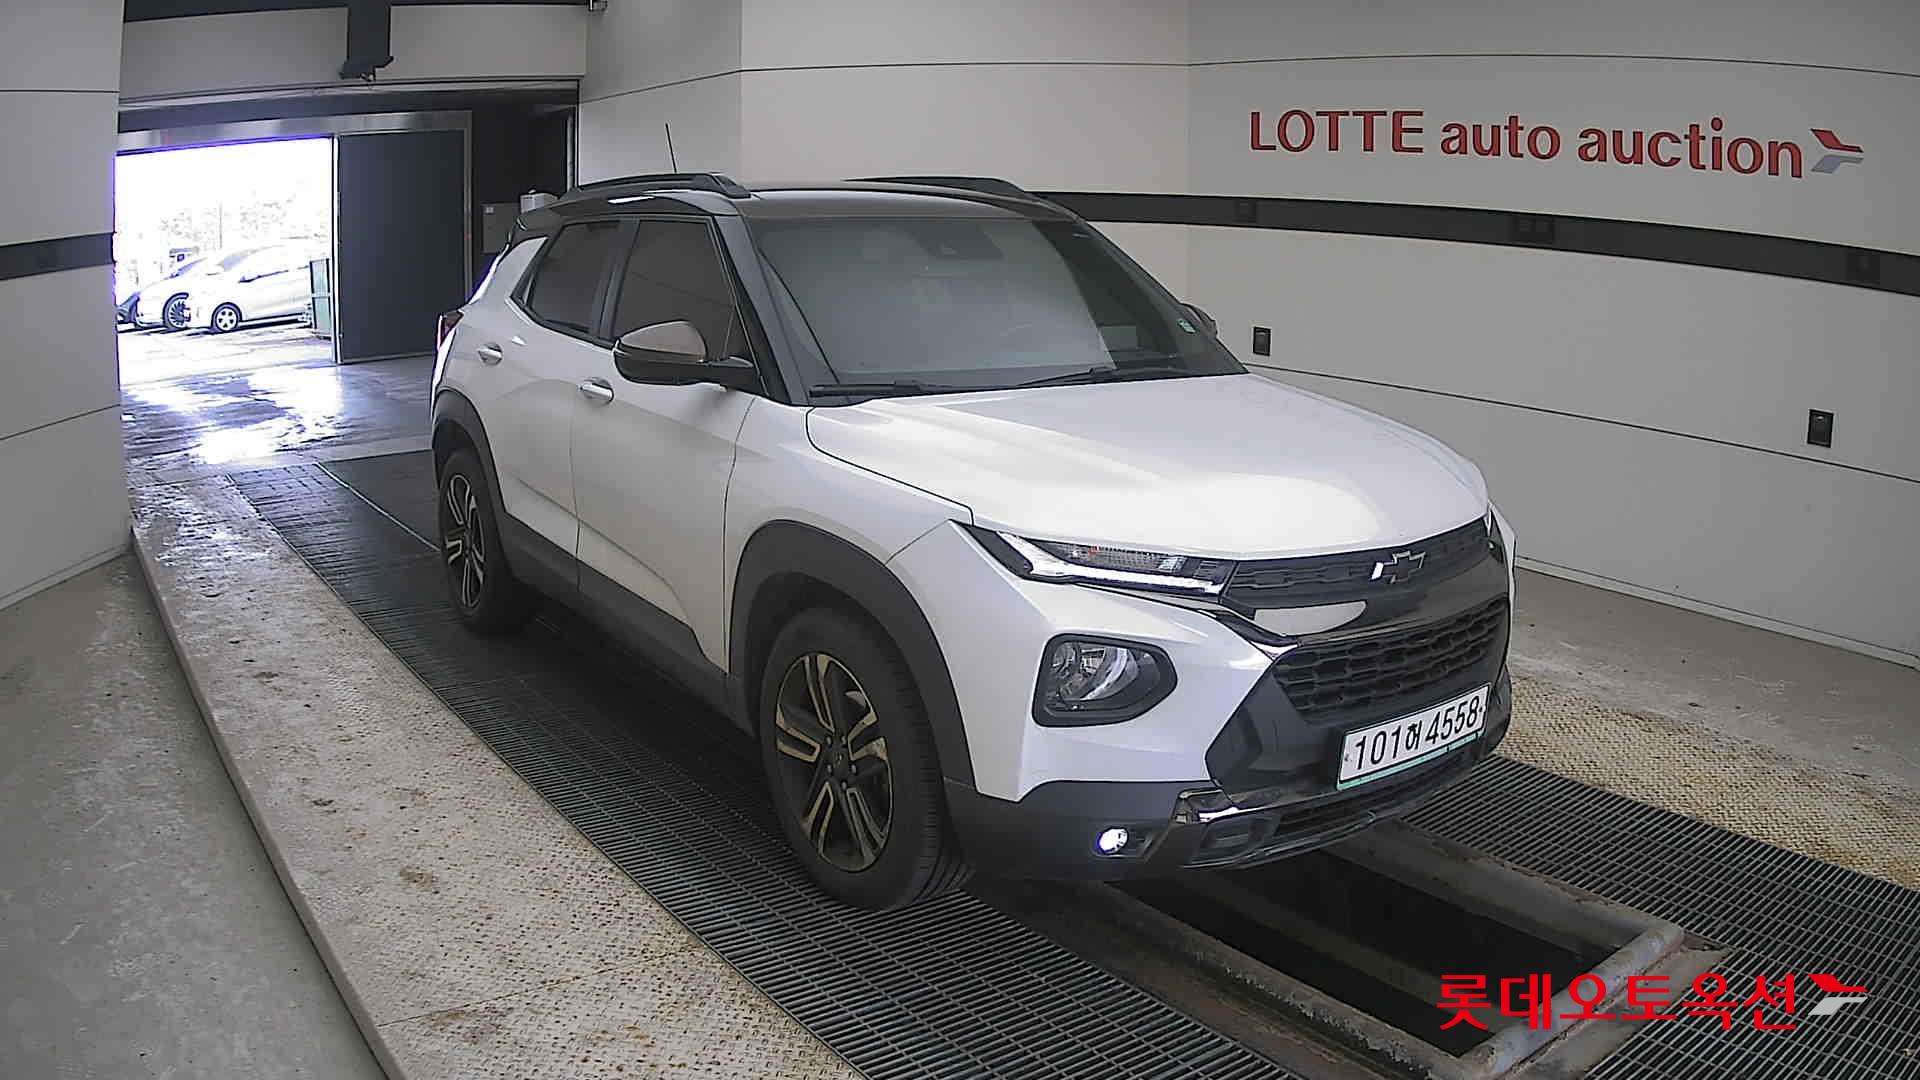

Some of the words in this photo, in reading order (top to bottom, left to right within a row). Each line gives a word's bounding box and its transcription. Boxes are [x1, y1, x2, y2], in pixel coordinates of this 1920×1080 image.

[1250, 109, 1424, 153] LOTTE
[1440, 115, 1561, 160] auto
[1577, 117, 1802, 178] auction
